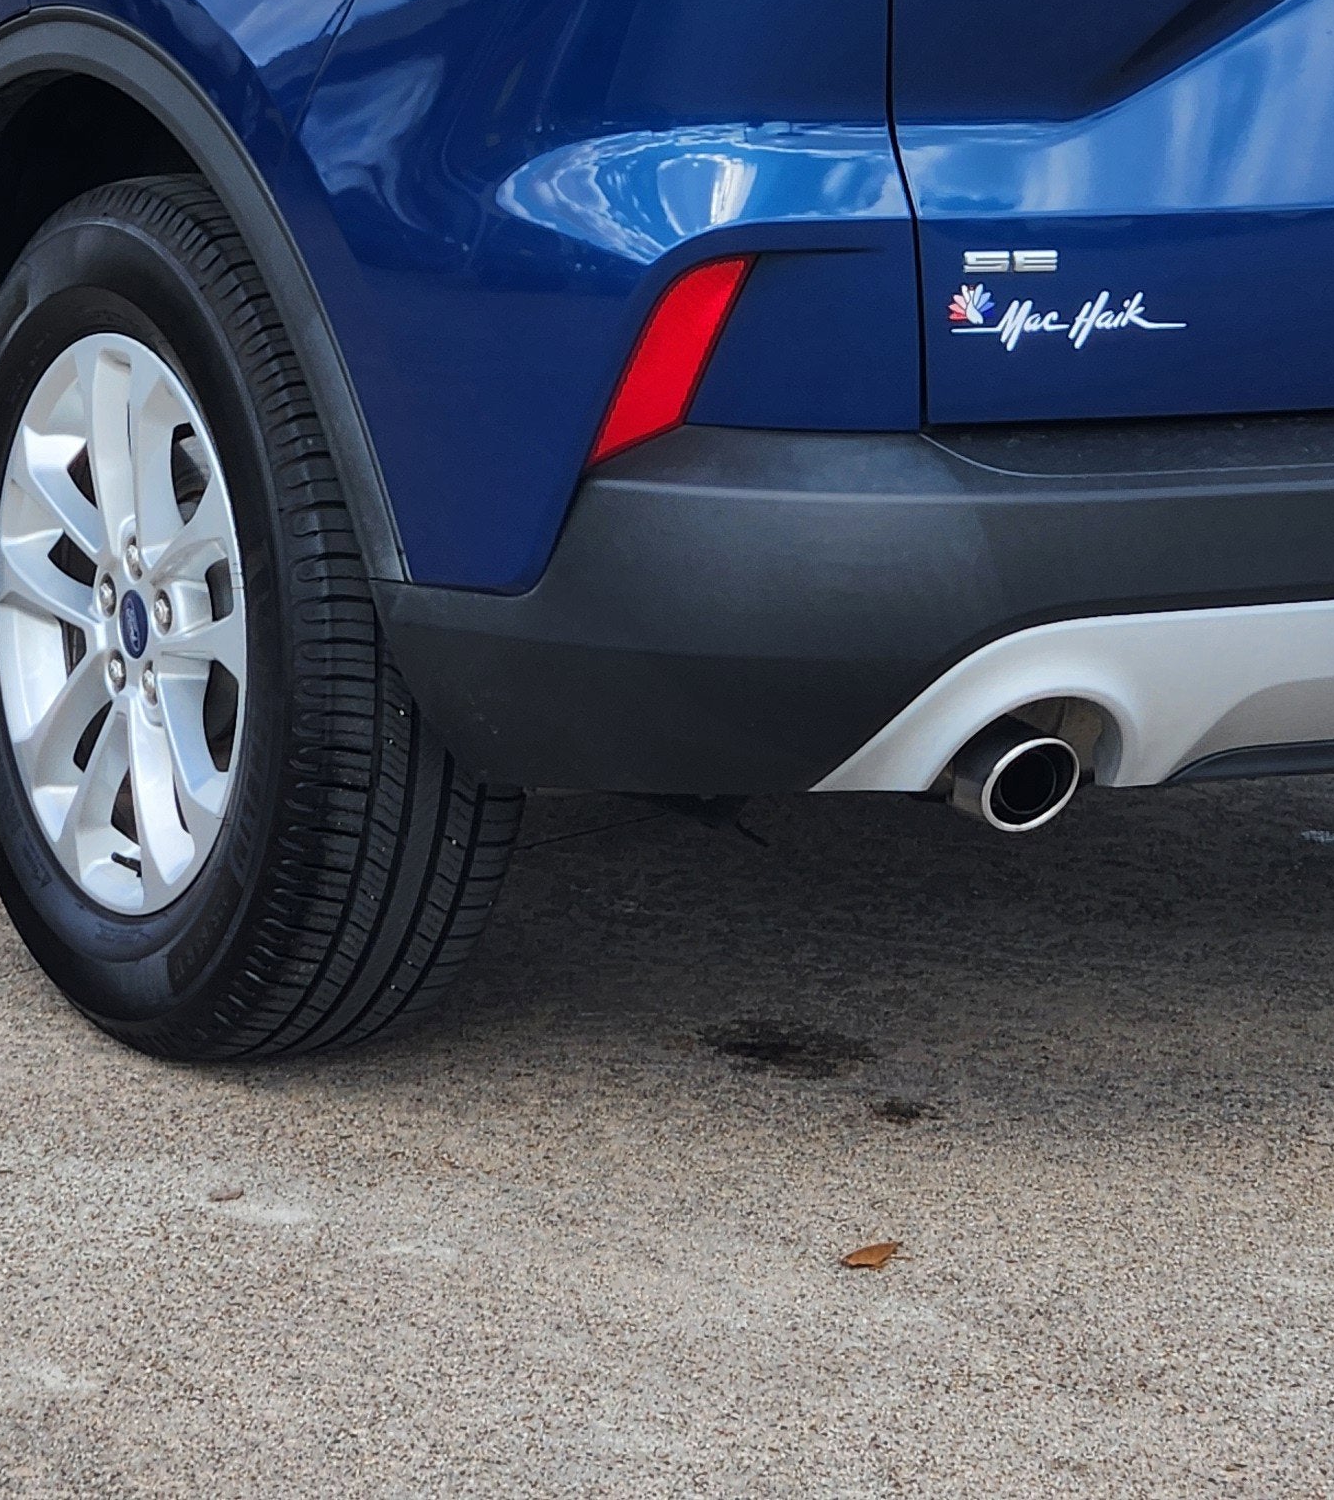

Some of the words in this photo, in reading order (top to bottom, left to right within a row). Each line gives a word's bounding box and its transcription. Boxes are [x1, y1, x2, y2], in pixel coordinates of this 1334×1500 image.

[963, 250, 1058, 273] SE
[999, 299, 1069, 351] Mac
[1068, 290, 1157, 349] Haik
